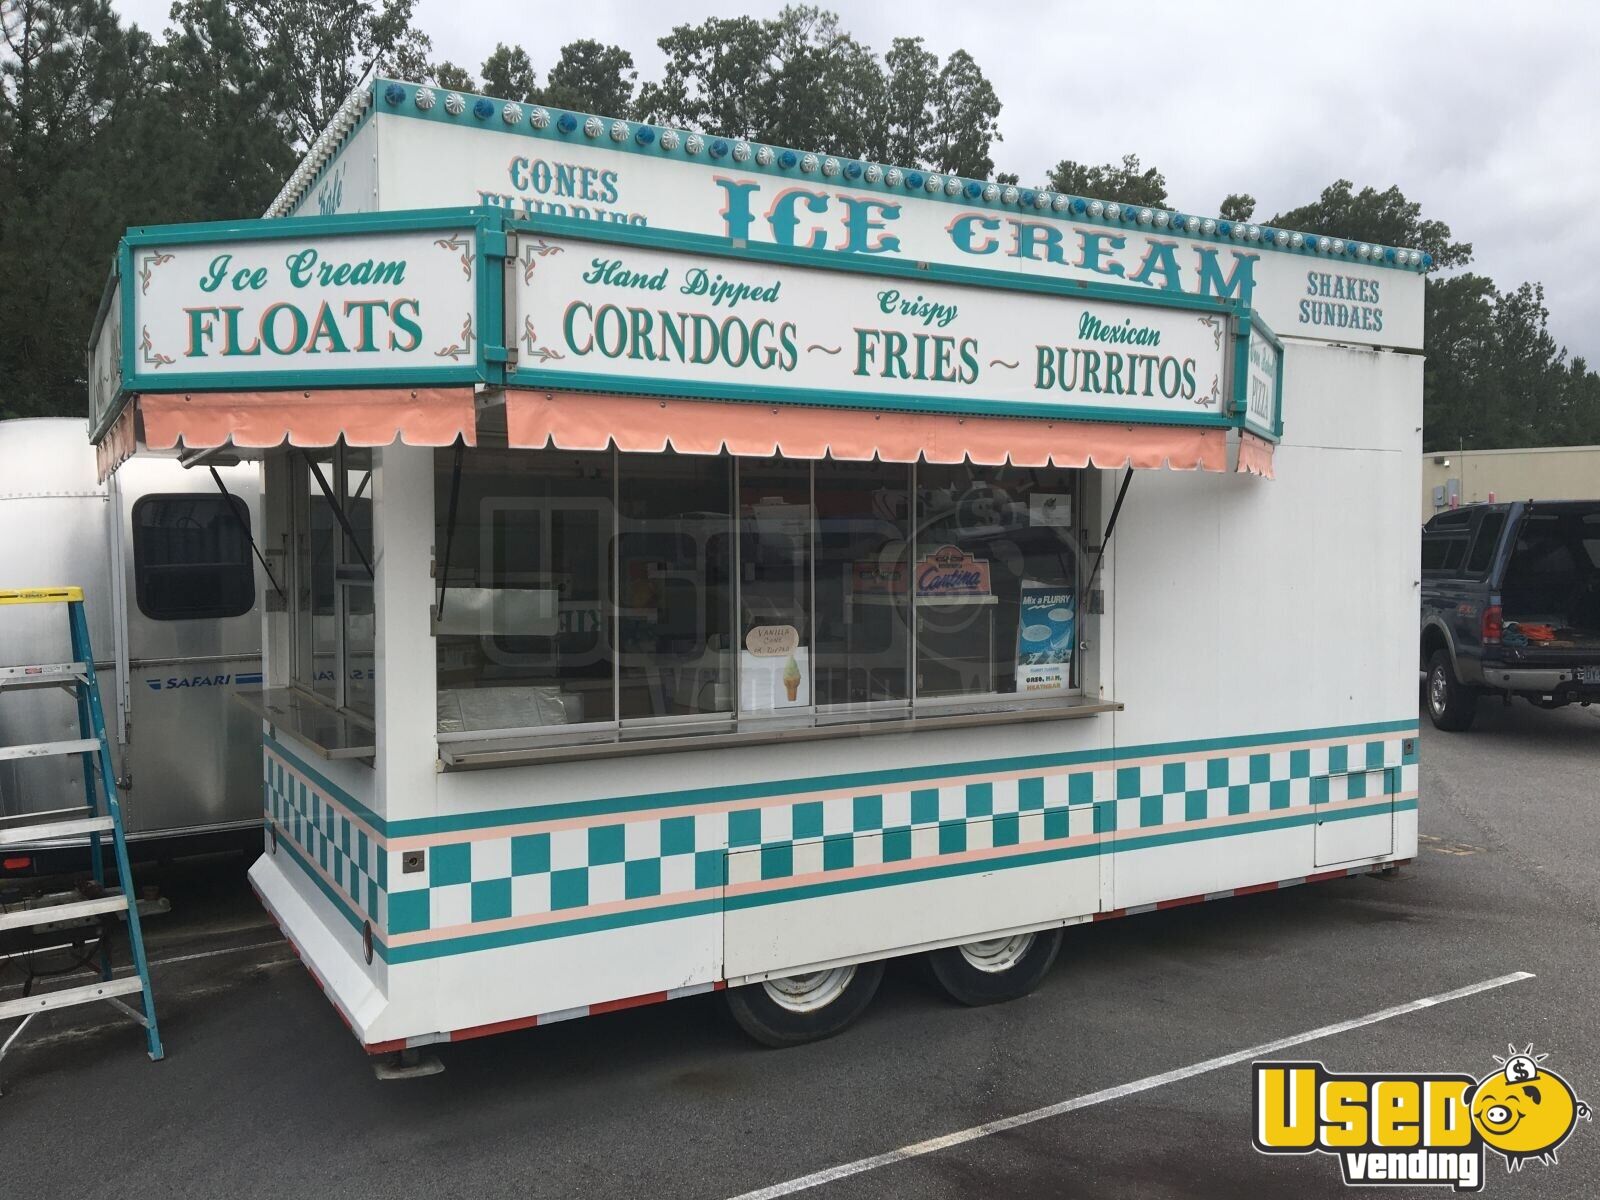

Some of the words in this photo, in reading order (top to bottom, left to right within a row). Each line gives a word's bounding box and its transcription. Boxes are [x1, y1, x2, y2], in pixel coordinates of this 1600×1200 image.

[508, 155, 619, 205] CONES
[712, 174, 902, 254] ICE
[944, 211, 1261, 308] CREAM
[199, 253, 268, 293] Ice
[285, 248, 407, 288] Cream
[582, 257, 669, 291] Hand
[680, 268, 782, 308] Dipped
[1306, 270, 1380, 304] SHAKES
[182, 298, 423, 358] FLOATS
[876, 289, 959, 328] Crispy
[1298, 298, 1383, 333] SUNDAES
[1078, 311, 1162, 347] Mexican
[562, 300, 798, 372] CORNDOGS
[853, 327, 980, 385] FRIES
[1034, 344, 1197, 401] BURRITOS
[918, 566, 981, 592] Cantina
[1043, 594, 1071, 604] FLURRY
[165, 674, 231, 689] SAFARI
